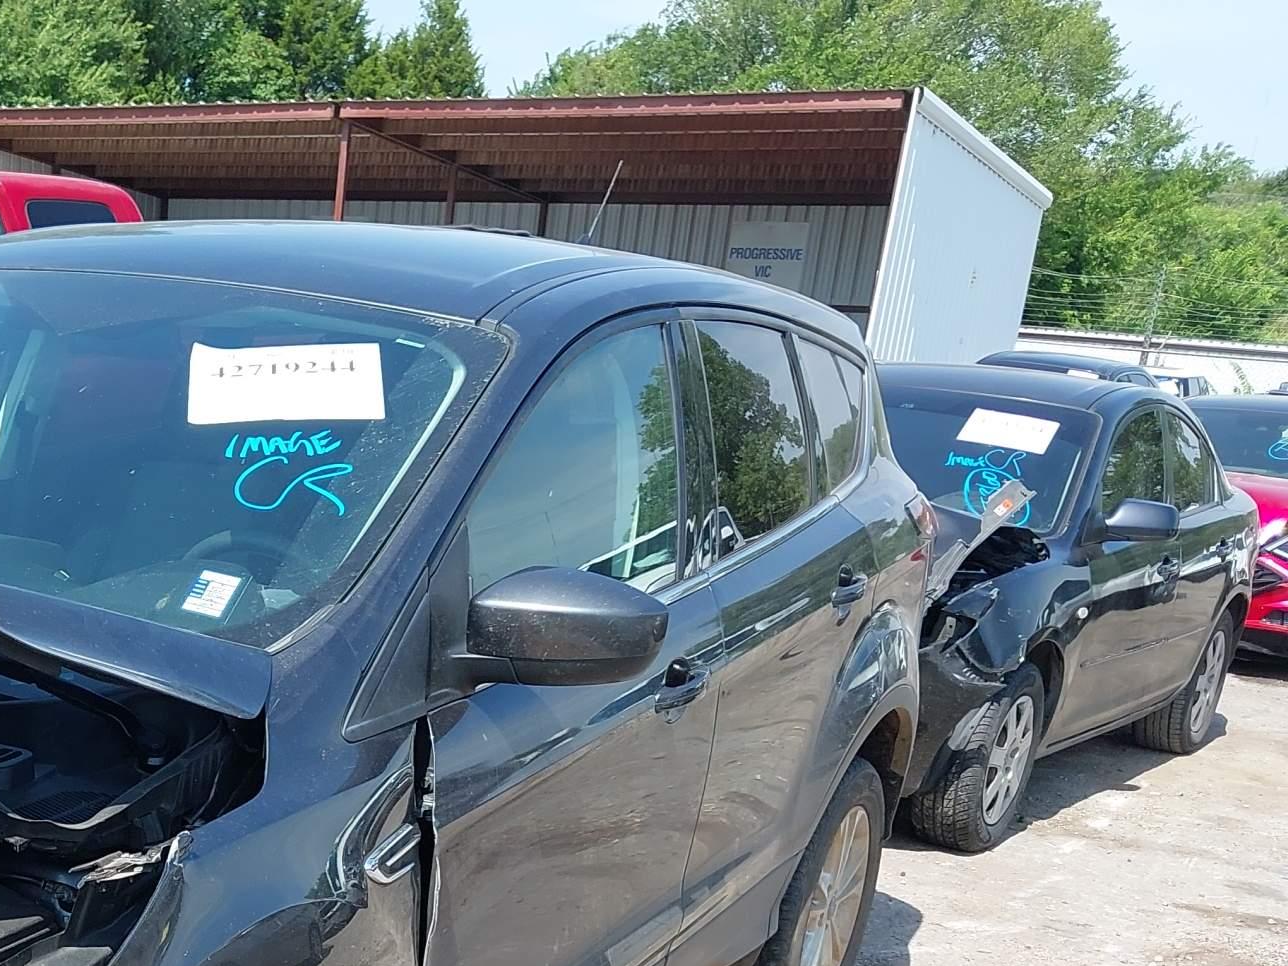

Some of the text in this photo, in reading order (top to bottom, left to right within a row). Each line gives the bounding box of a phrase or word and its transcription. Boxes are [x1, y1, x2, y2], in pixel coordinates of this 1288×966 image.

[729, 247, 804, 261] PROGRESSIVE
[754, 265, 772, 278] VIC
[211, 360, 355, 378] 42719244
[224, 429, 342, 459] IMAGE
[233, 455, 354, 517] CR
